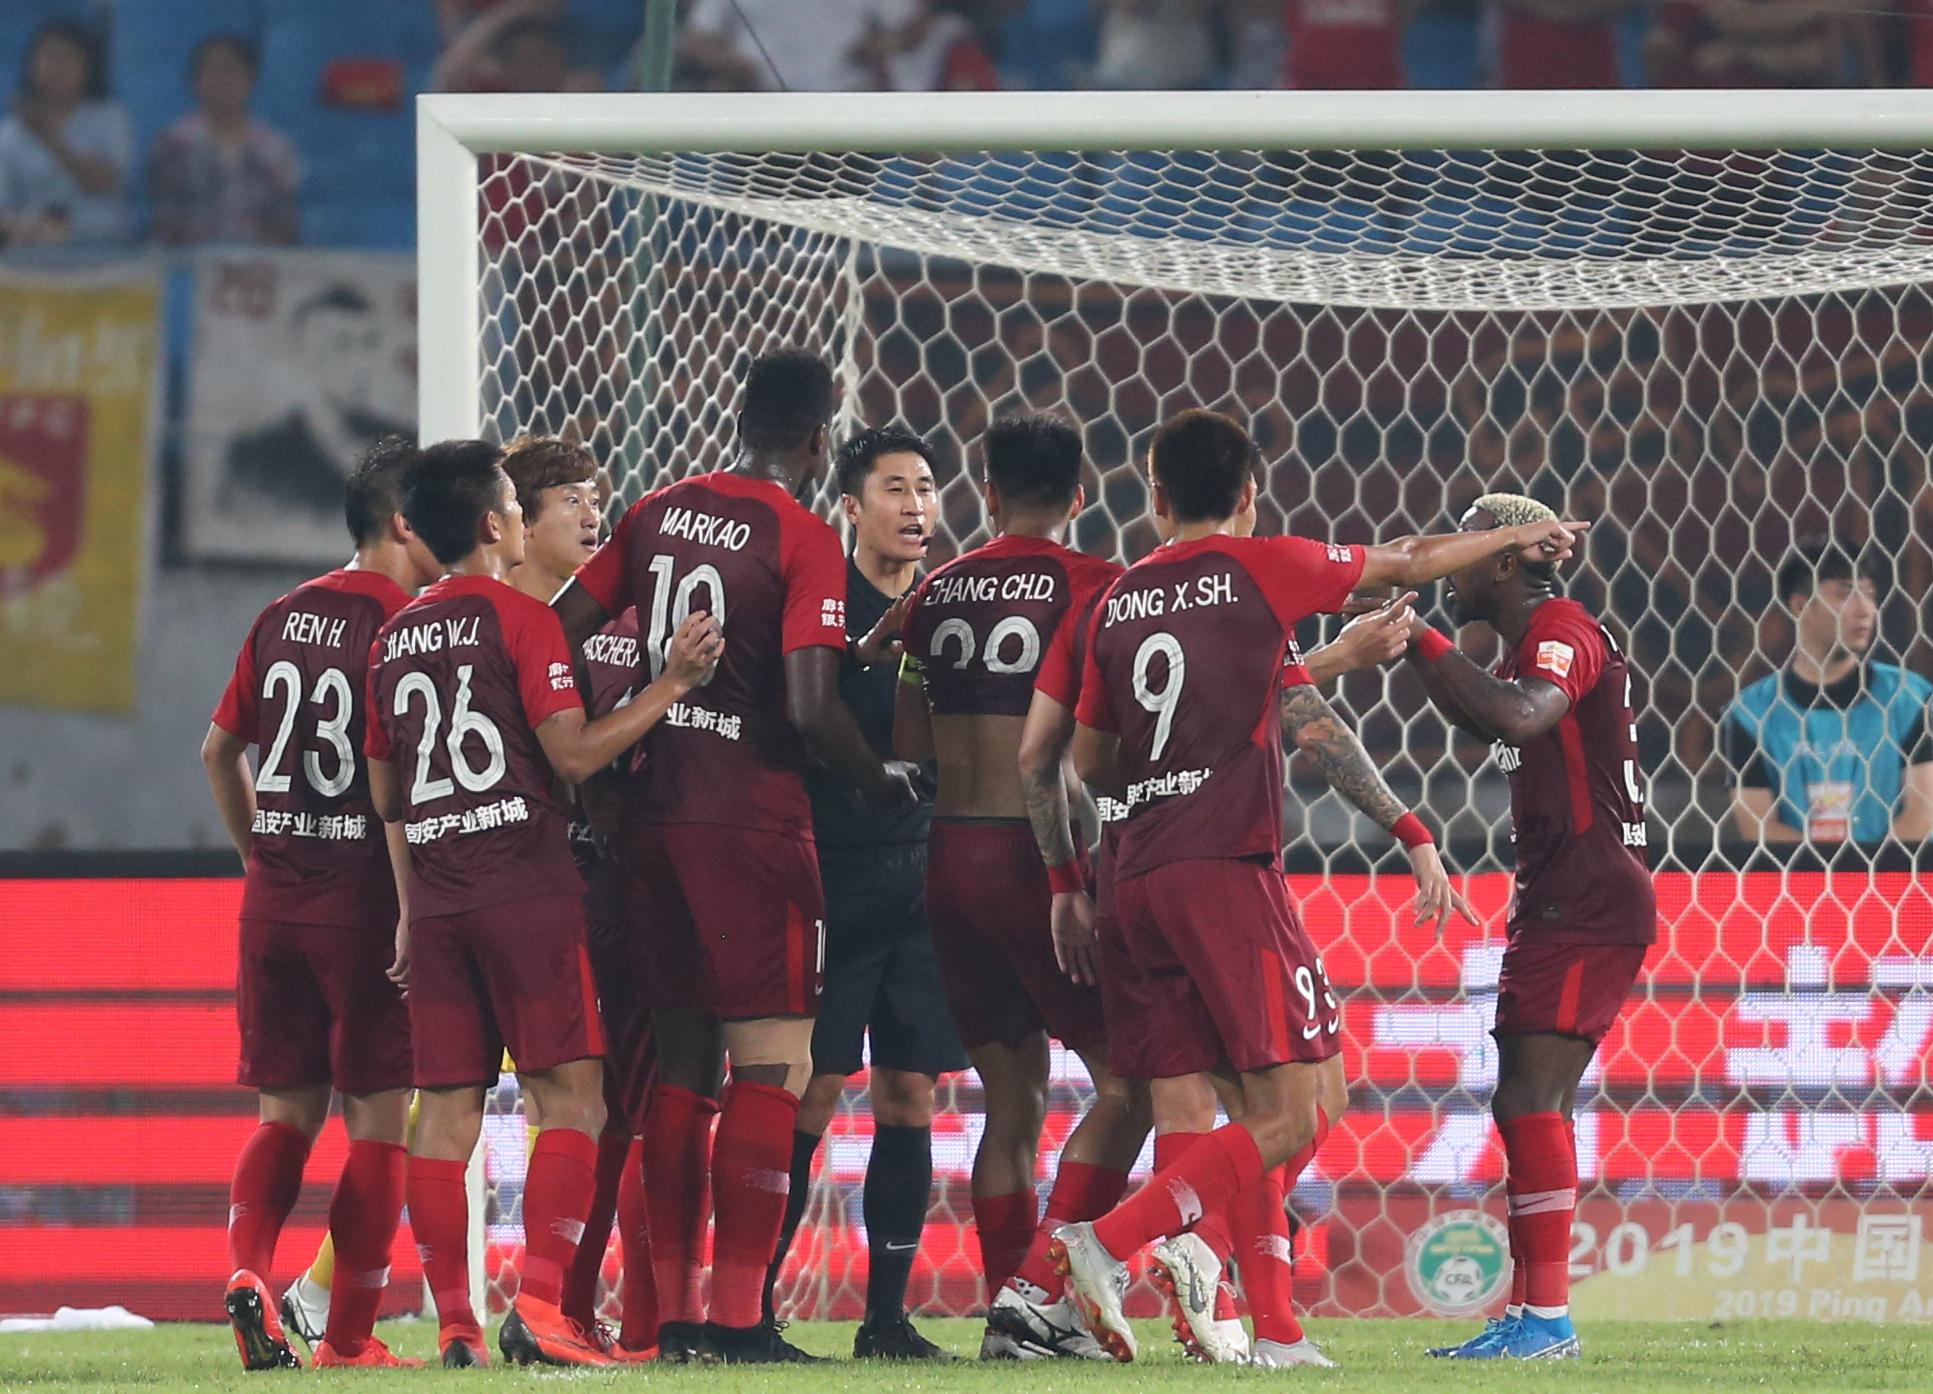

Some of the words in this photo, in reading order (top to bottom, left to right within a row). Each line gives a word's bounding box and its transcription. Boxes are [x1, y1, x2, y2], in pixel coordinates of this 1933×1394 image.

[659, 506, 751, 551] MARKAO
[924, 576, 999, 606] ZHANG
[1001, 573, 1055, 603] CH.D.
[1105, 588, 1166, 628] DONG
[1171, 573, 1239, 612] X.SH.
[282, 611, 328, 646] REN
[326, 618, 347, 648] H.
[383, 622, 443, 663] JIANG
[445, 616, 480, 647] W.J.
[648, 554, 726, 687] 10
[582, 634, 640, 668] ASCHER
[1132, 632, 1185, 761] 9
[256, 661, 355, 798] 23
[394, 665, 506, 805] 26
[664, 702, 742, 741] 业新城
[251, 809, 368, 840] 固安产业新城
[405, 797, 529, 845] 固安产业新城
[1808, 1290, 1888, 1322] Ping
[1896, 1289, 1933, 1317] A
